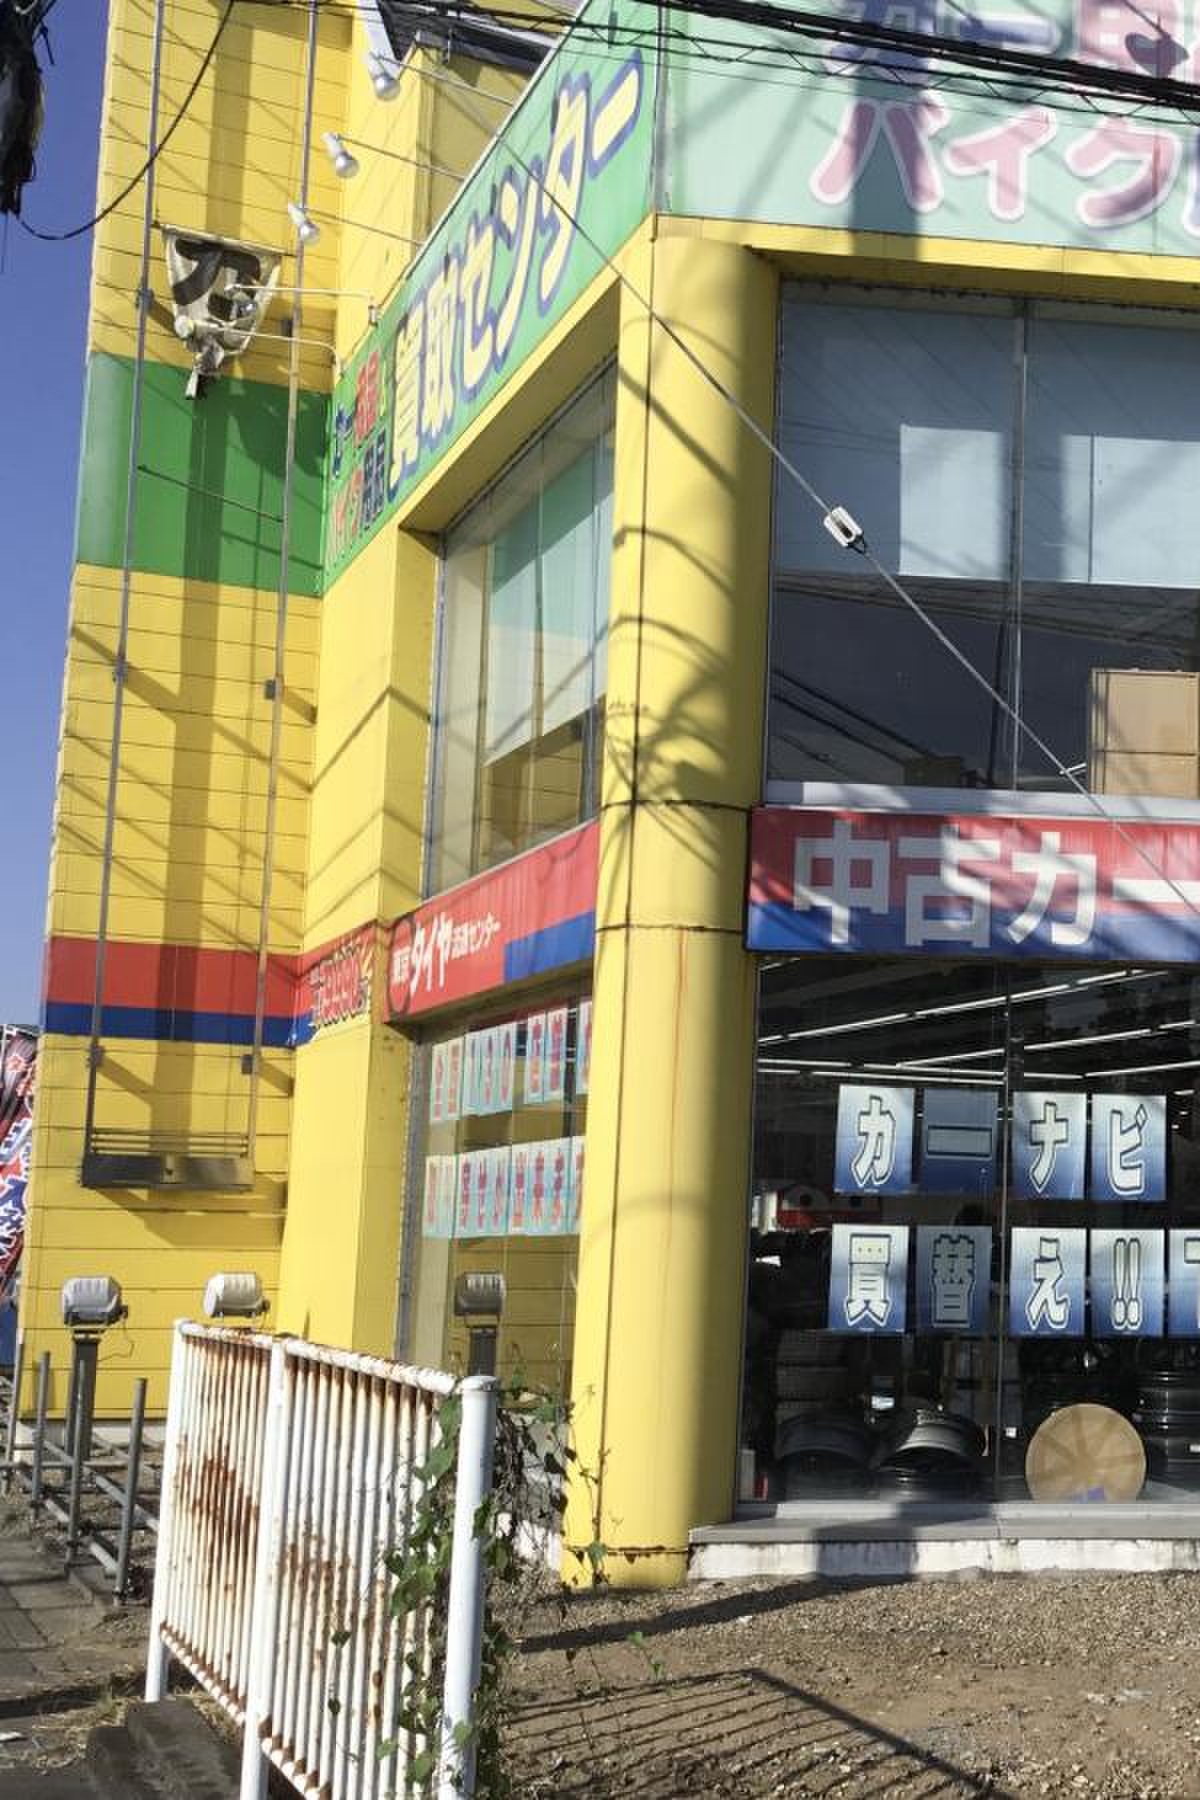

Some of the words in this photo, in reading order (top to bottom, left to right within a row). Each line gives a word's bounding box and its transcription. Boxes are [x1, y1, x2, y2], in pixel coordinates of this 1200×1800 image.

[388, 58, 640, 495] 買取センター
[849, 1095, 1149, 1197] カーナビ
